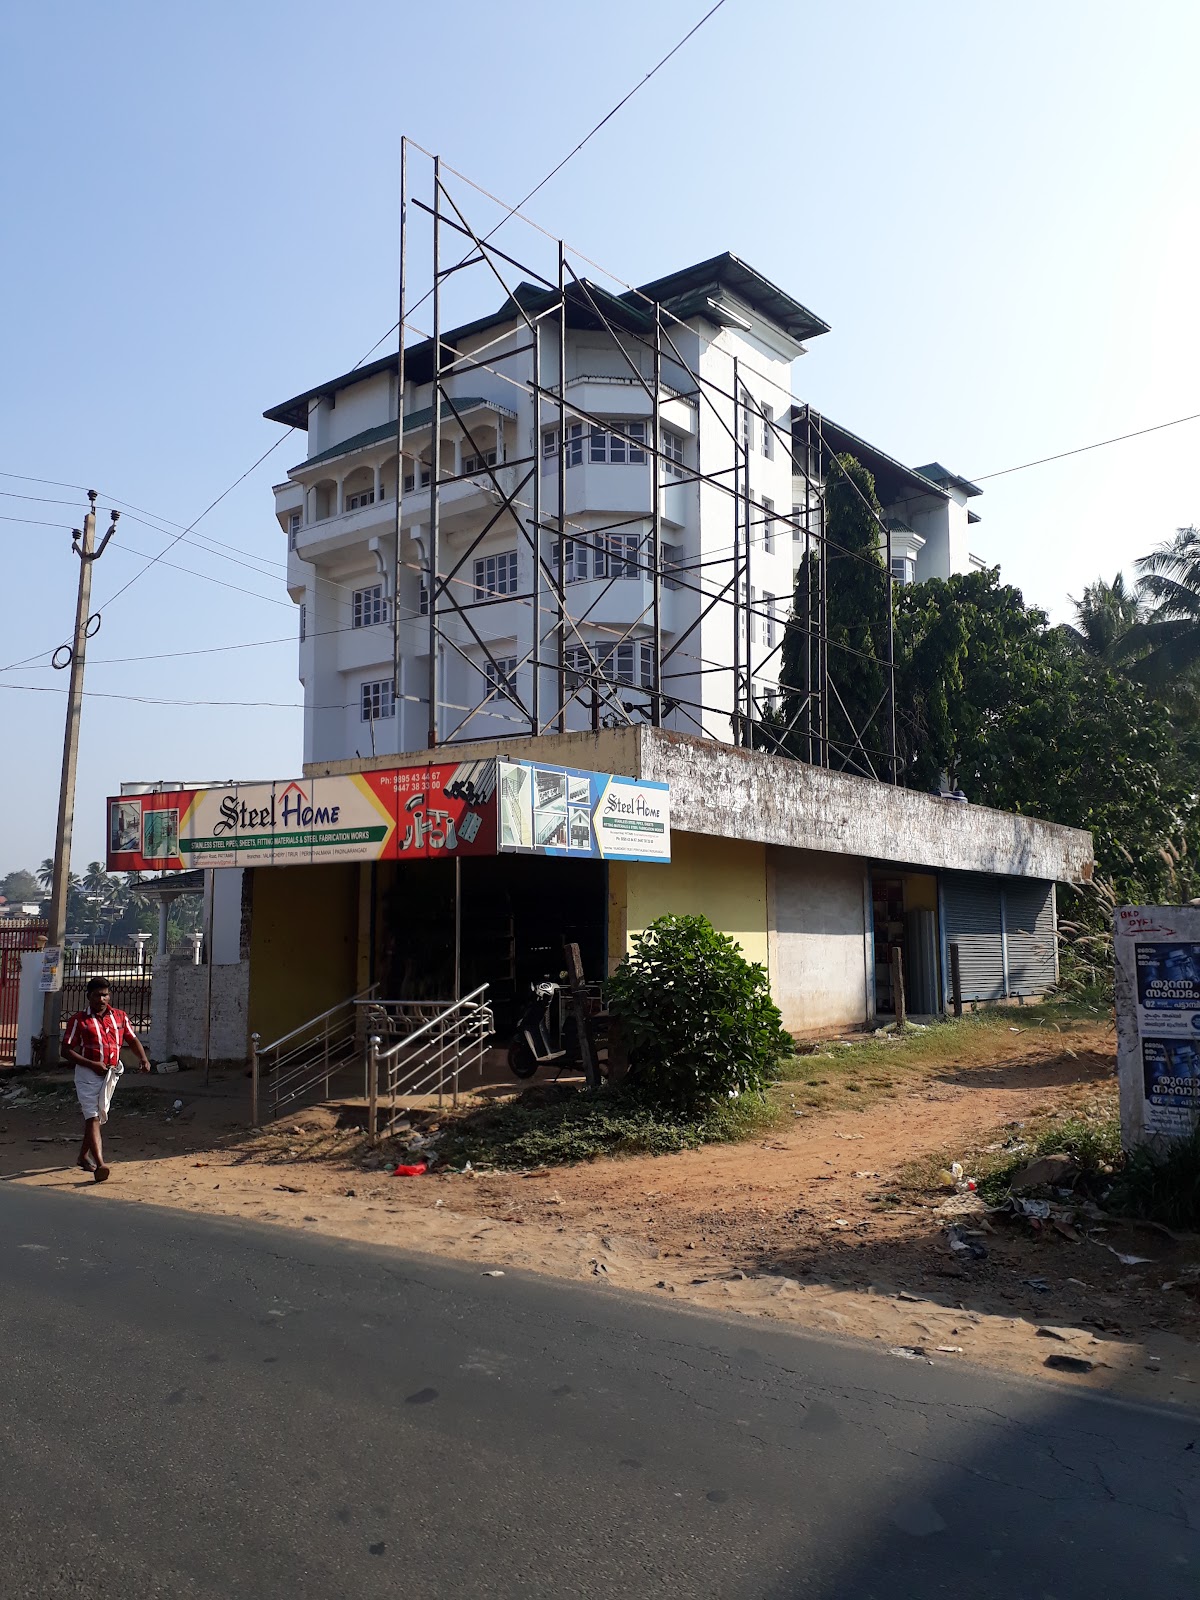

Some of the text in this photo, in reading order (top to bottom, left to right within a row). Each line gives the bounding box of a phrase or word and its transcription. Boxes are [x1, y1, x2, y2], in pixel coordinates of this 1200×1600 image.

[380, 771, 441, 785] Ph: 9895 43 44 67
[393, 780, 441, 793] 9447 38 33 00
[603, 793, 635, 815] Steel
[213, 794, 277, 836] Steel
[191, 841, 212, 850] STAINLESS
[213, 840, 225, 849] STEEL
[239, 838, 256, 848] SHEETS,
[257, 837, 273, 846] FITTING
[274, 835, 299, 846] MATERIALS
[304, 833, 318, 843] STEEL
[319, 831, 350, 842] FABRICATION
[351, 830, 370, 840] WORKS
[1151, 980, 1193, 991] തുറന്ന
[1145, 989, 1200, 1000] സംവാദം
[1145, 1000, 1156, 1008] 02
[1152, 1096, 1162, 1104] 02
